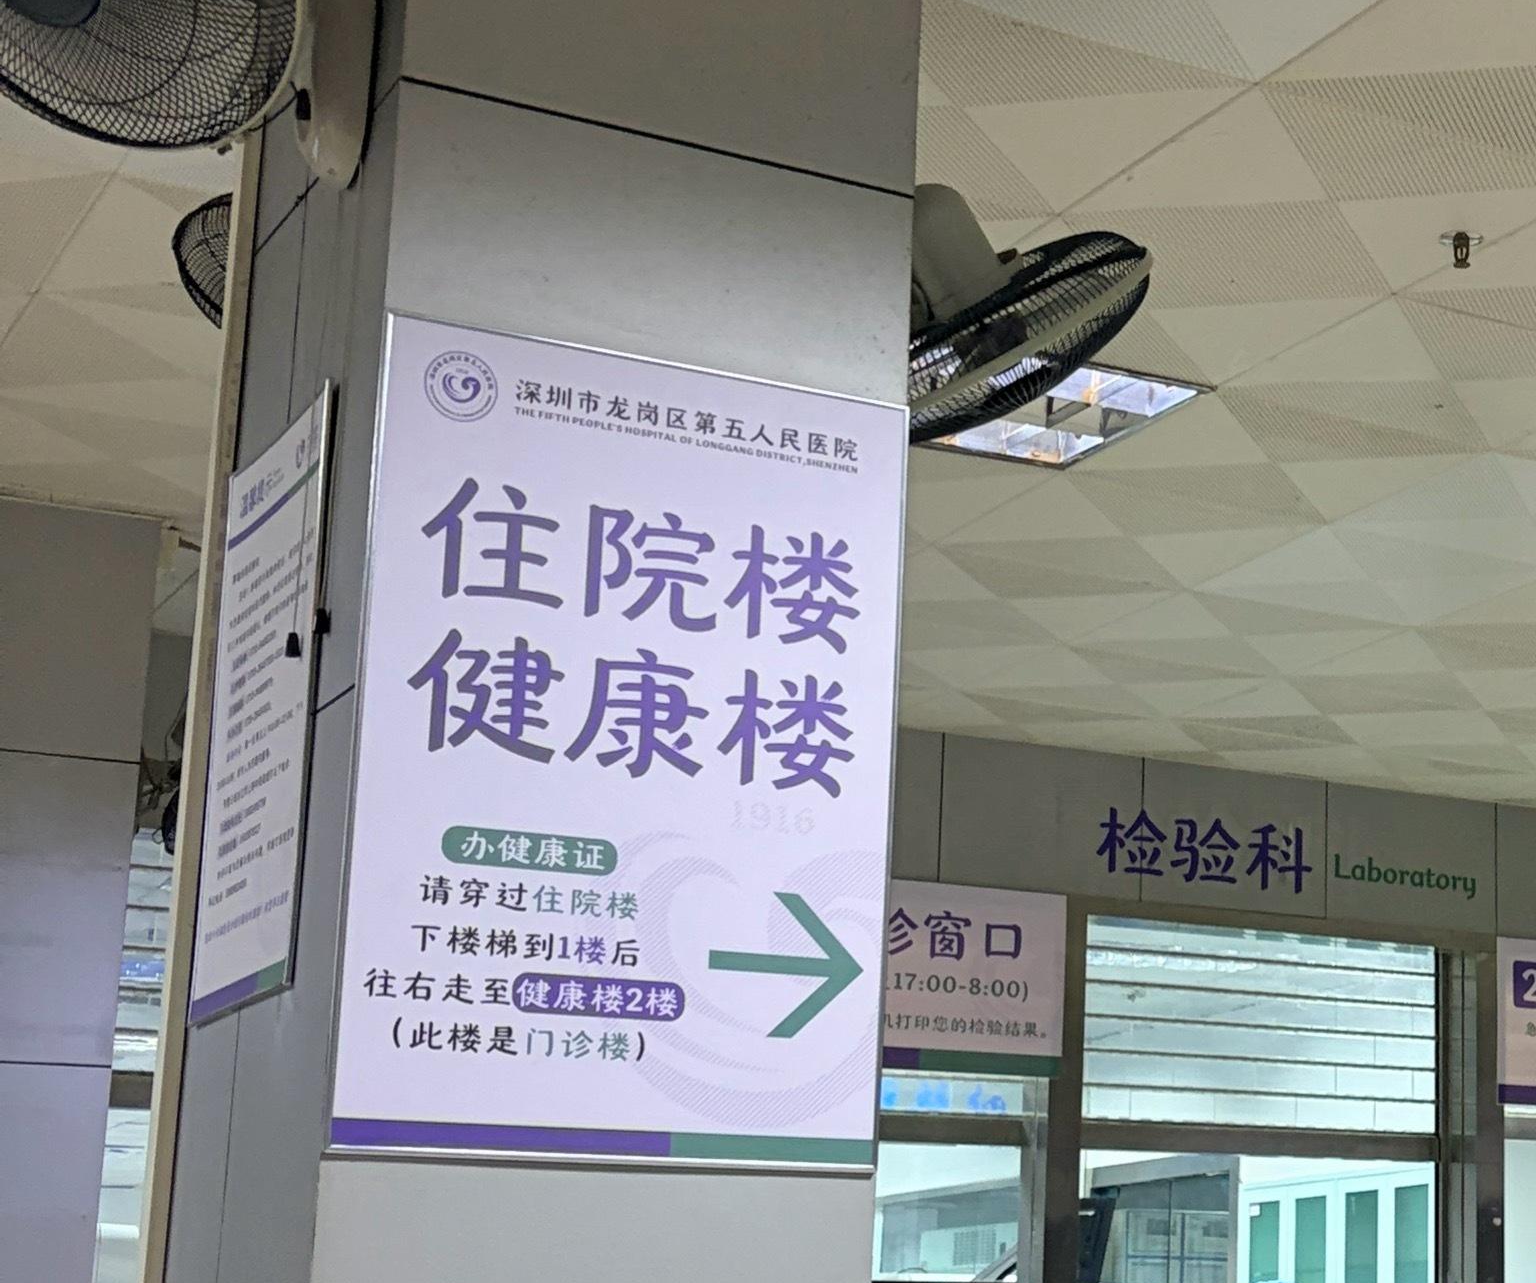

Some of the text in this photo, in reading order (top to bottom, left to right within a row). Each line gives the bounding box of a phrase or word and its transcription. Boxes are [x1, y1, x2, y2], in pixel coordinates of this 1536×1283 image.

[514, 406, 535, 418] THE
[538, 410, 570, 423] FIFTH
[572, 416, 623, 433] PEOPLE'S
[624, 425, 676, 442] HOSPITAL
[680, 435, 692, 445] OF
[696, 439, 754, 456] LONGGANG
[515, 378, 859, 461] 深圳市龙岗区第五人民医院
[421, 477, 861, 654] 住院楼
[406, 628, 854, 798] 健康楼
[459, 830, 607, 871] 办健康证
[1096, 807, 1313, 894] 检验科
[418, 874, 639, 921] 请穿过住院楼
[1334, 853, 1477, 900] Laboratory
[411, 924, 640, 967] 下楼梯到1楼后
[363, 967, 679, 1019] 往右走至健康楼2楼
[886, 973, 1029, 1002] 17:00-8:00)
[392, 1017, 647, 1062] (此楼是门诊楼)
